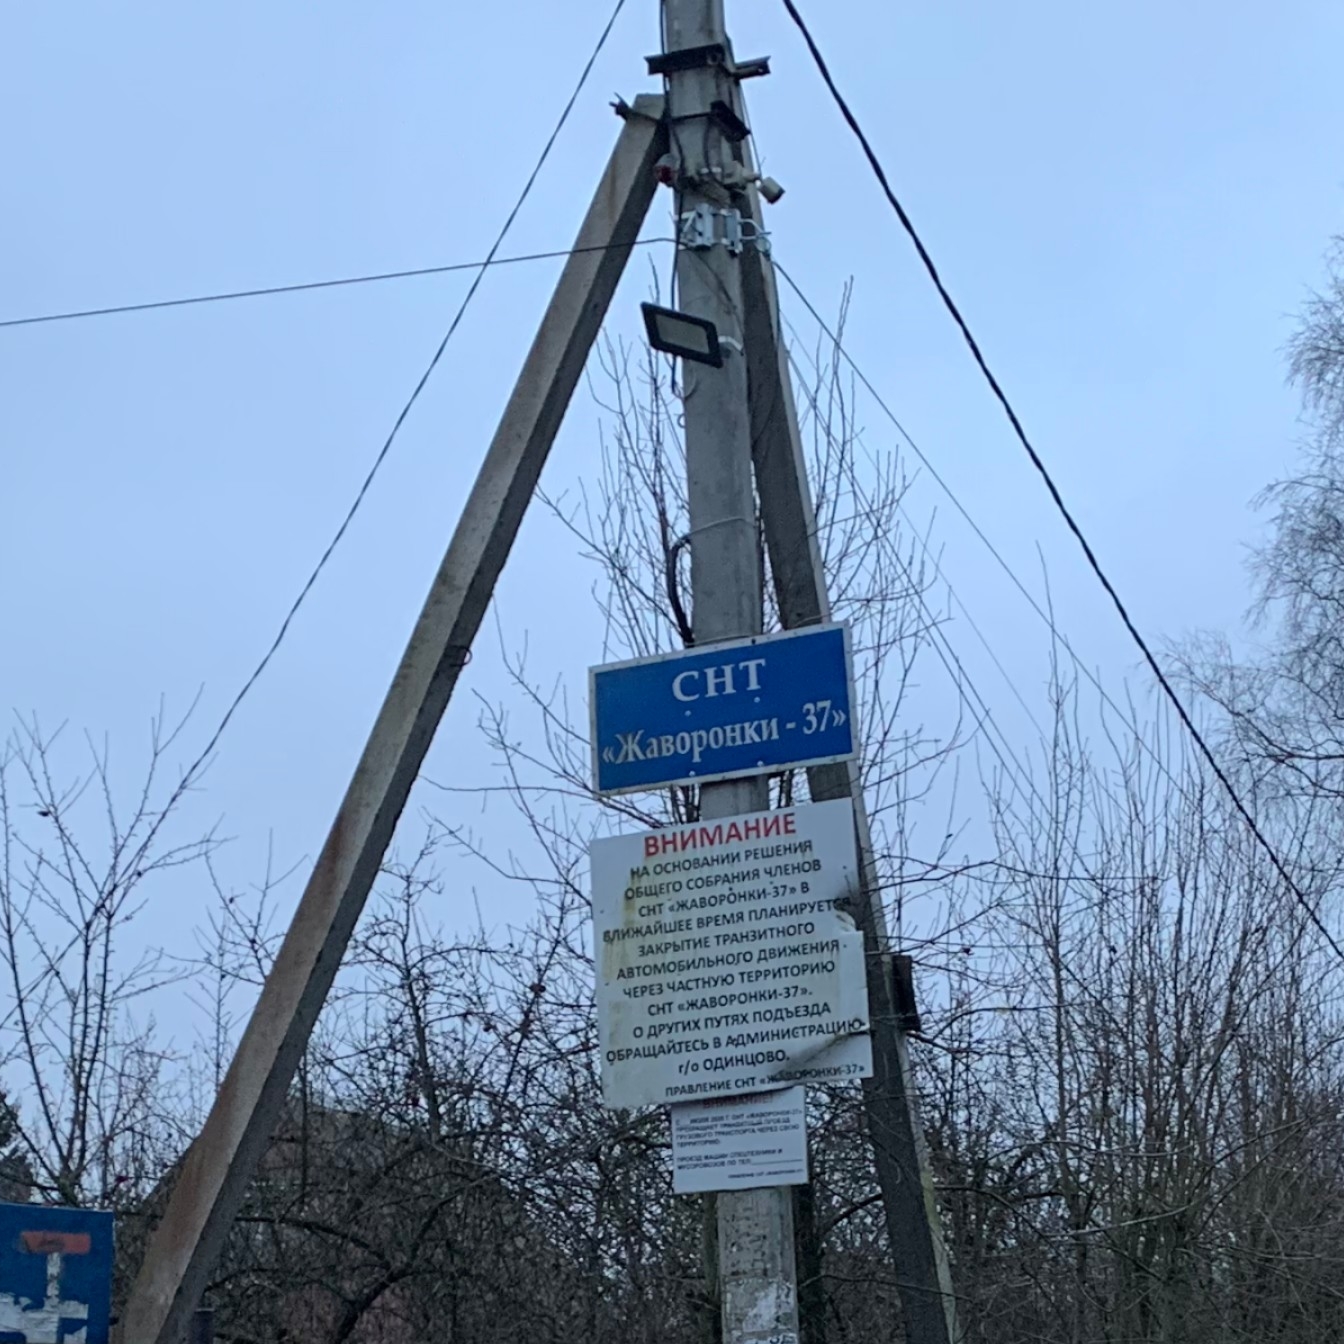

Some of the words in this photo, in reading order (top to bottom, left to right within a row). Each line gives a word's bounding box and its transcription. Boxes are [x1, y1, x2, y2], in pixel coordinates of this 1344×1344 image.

[672, 658, 766, 702] СНТ
[602, 716, 779, 764] «Жаворонки
[803, 700, 846, 734] 37»
[645, 812, 796, 857] ВНИМАНИЕ
[631, 867, 649, 881] НА
[653, 852, 740, 875] ОСНОВАНИИ
[744, 840, 812, 861] РЕШЕНИЯ
[625, 880, 683, 901] ОБЩЕГО
[686, 868, 760, 891] СОБРАНИЯ
[763, 859, 822, 880] ЧЛЕНОВ
[638, 904, 664, 917] СНТ
[668, 885, 796, 913] «ЖАВОРОНКИ-37»
[800, 882, 810, 893] В
[603, 920, 693, 943] БЛИЖАЙШЕЕ
[697, 912, 744, 929] ВРЕМЯ
[638, 938, 711, 957] ЗАКРЫТИЕ
[715, 922, 814, 946] ТРАНЗИТНОГО
[617, 951, 753, 980] АВТОМОБИЛЬНОГО
[757, 940, 839, 964] ДВИЖЕНИЯ
[623, 984, 664, 999] ЧЕРЕЗ
[667, 974, 735, 993] ЧАСТНУЮ
[739, 960, 835, 984] ТЕРРИТОРИЮ
[648, 1003, 673, 1016] СНТ
[677, 986, 812, 1012] «ЖАВОРОНКИ-37».
[633, 1026, 643, 1038] О
[647, 1019, 700, 1040] ДРУГИХ
[704, 1012, 749, 1029] ПУТЯХ
[753, 1002, 831, 1025] ПОДЪЕЗДА
[607, 1036, 709, 1064] ОБРАЩАЙТЕСЬ
[714, 1035, 721, 1048] В
[726, 1018, 863, 1048] АДМИНИСТРАЦИЮ
[678, 1060, 699, 1075] г/о
[704, 1049, 790, 1074] ОДИНЦОВО.
[665, 1080, 731, 1096] ПРАВЛЕНИЕ
[735, 1077, 756, 1088] СНТ
[715, 1128, 756, 1136] ТРАНСПОРТА
